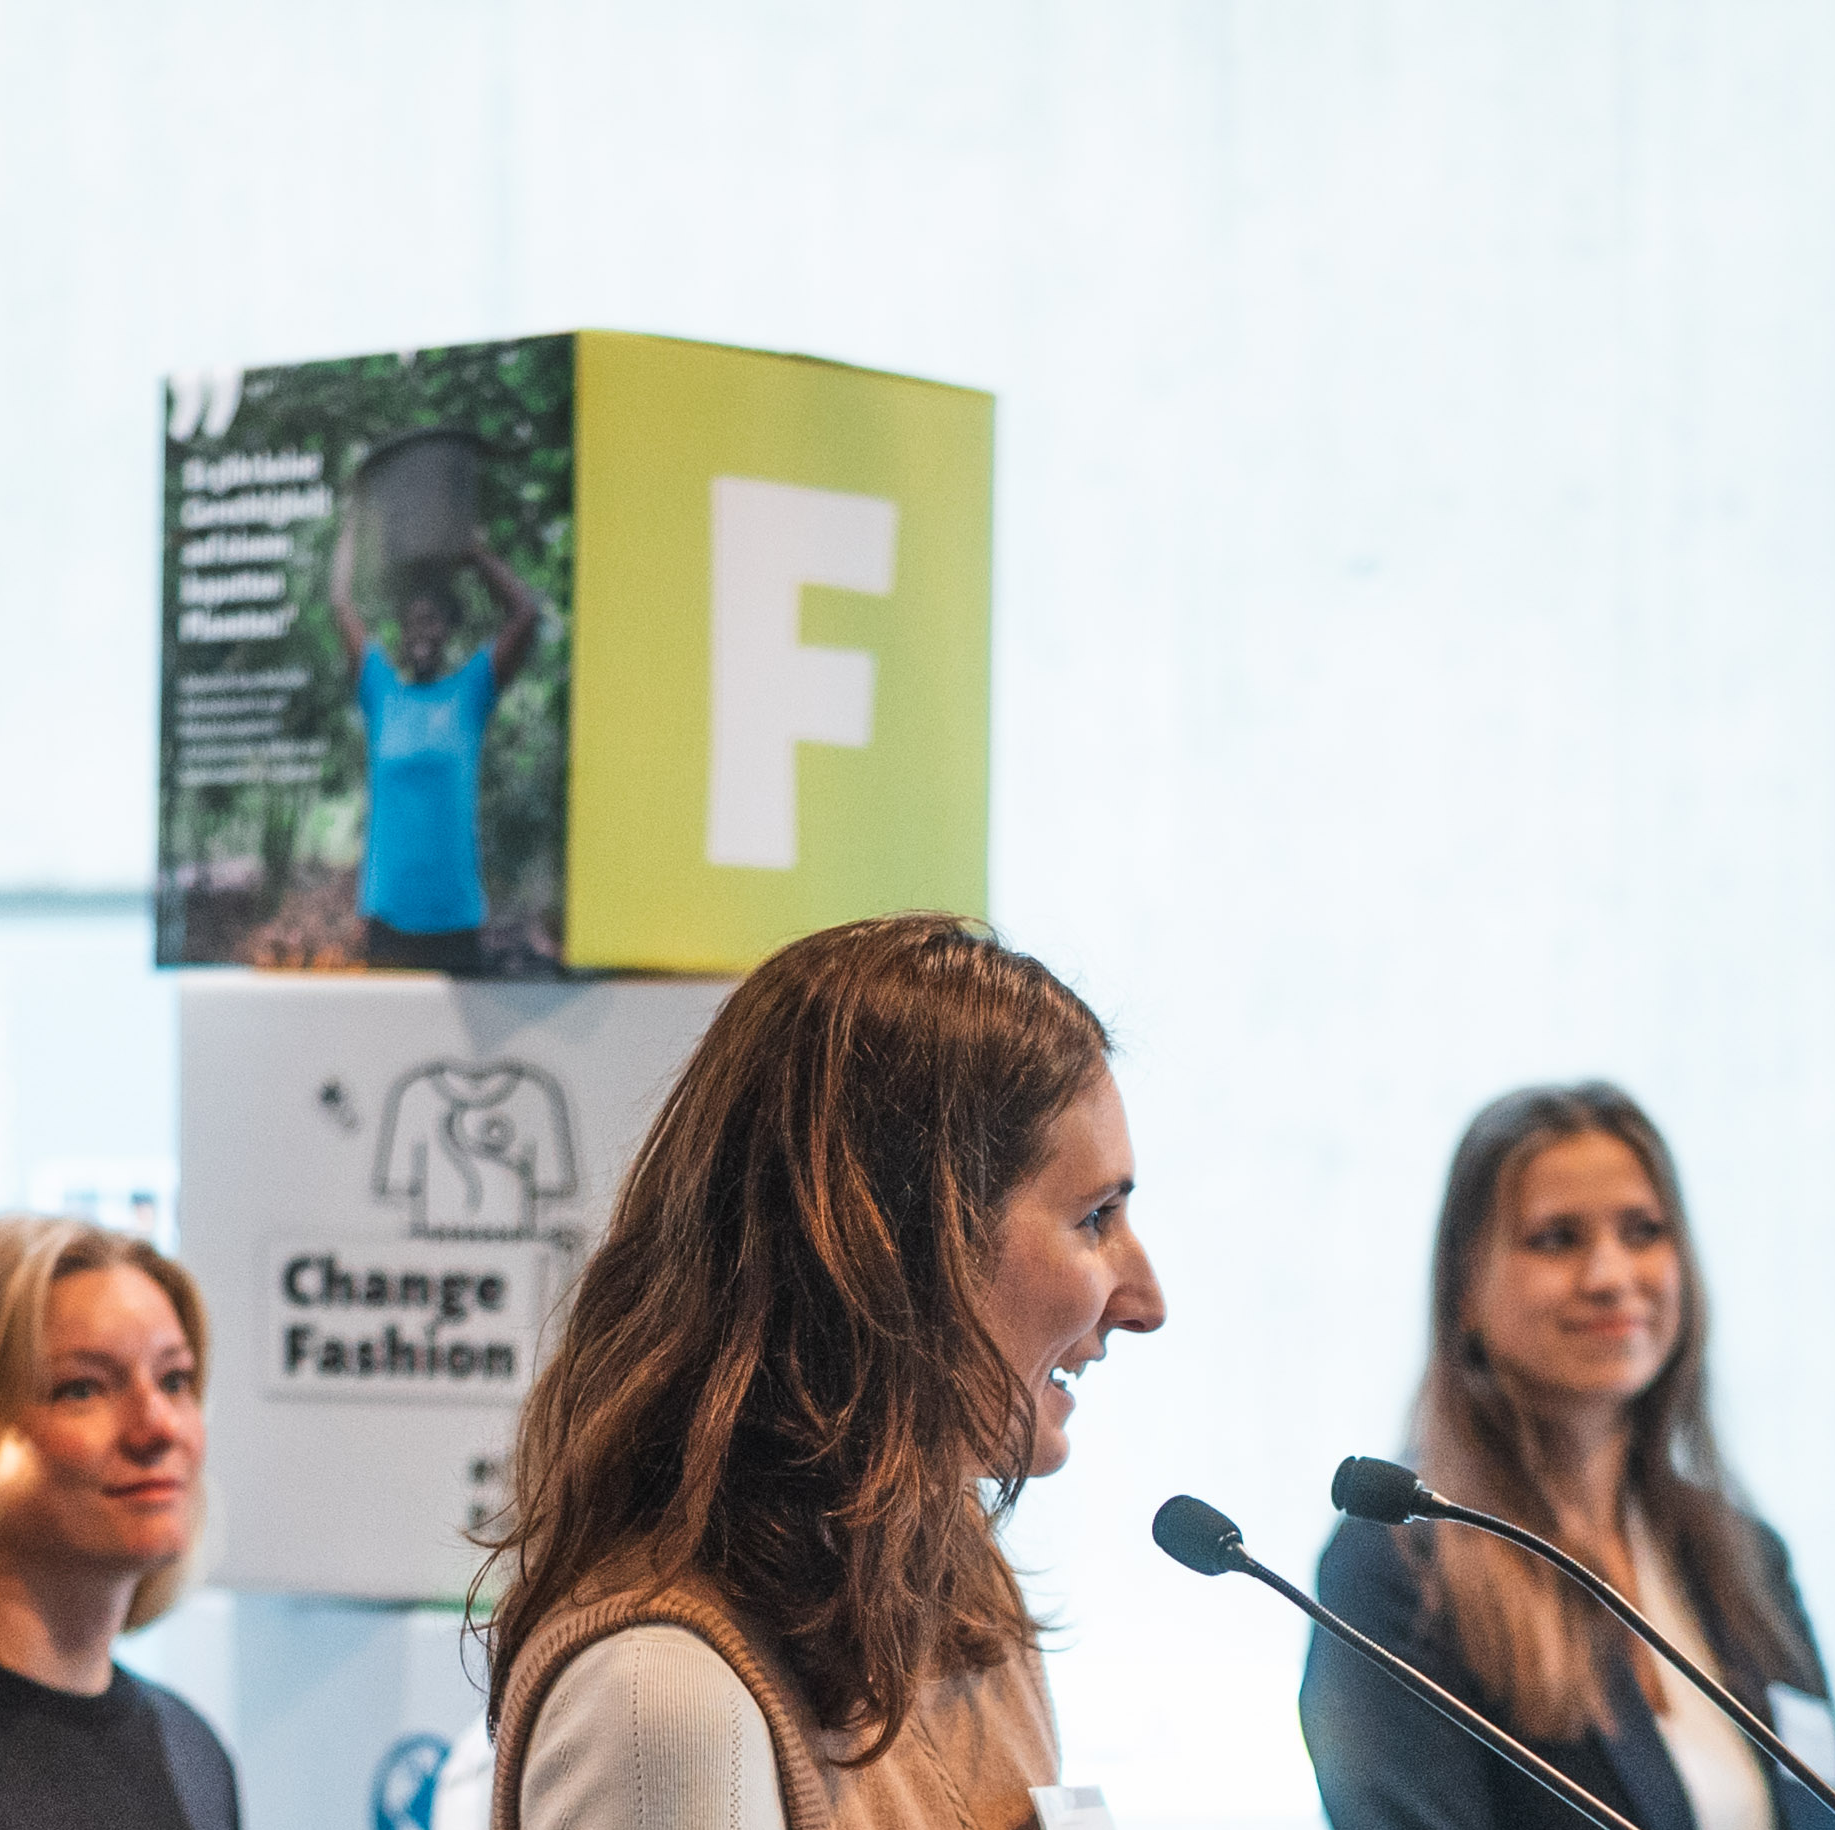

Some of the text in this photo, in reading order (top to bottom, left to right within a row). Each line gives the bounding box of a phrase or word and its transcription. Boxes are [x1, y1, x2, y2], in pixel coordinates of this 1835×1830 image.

[706, 476, 898, 870] F
[281, 1253, 506, 1324] Change
[283, 1321, 515, 1379] Fashion
